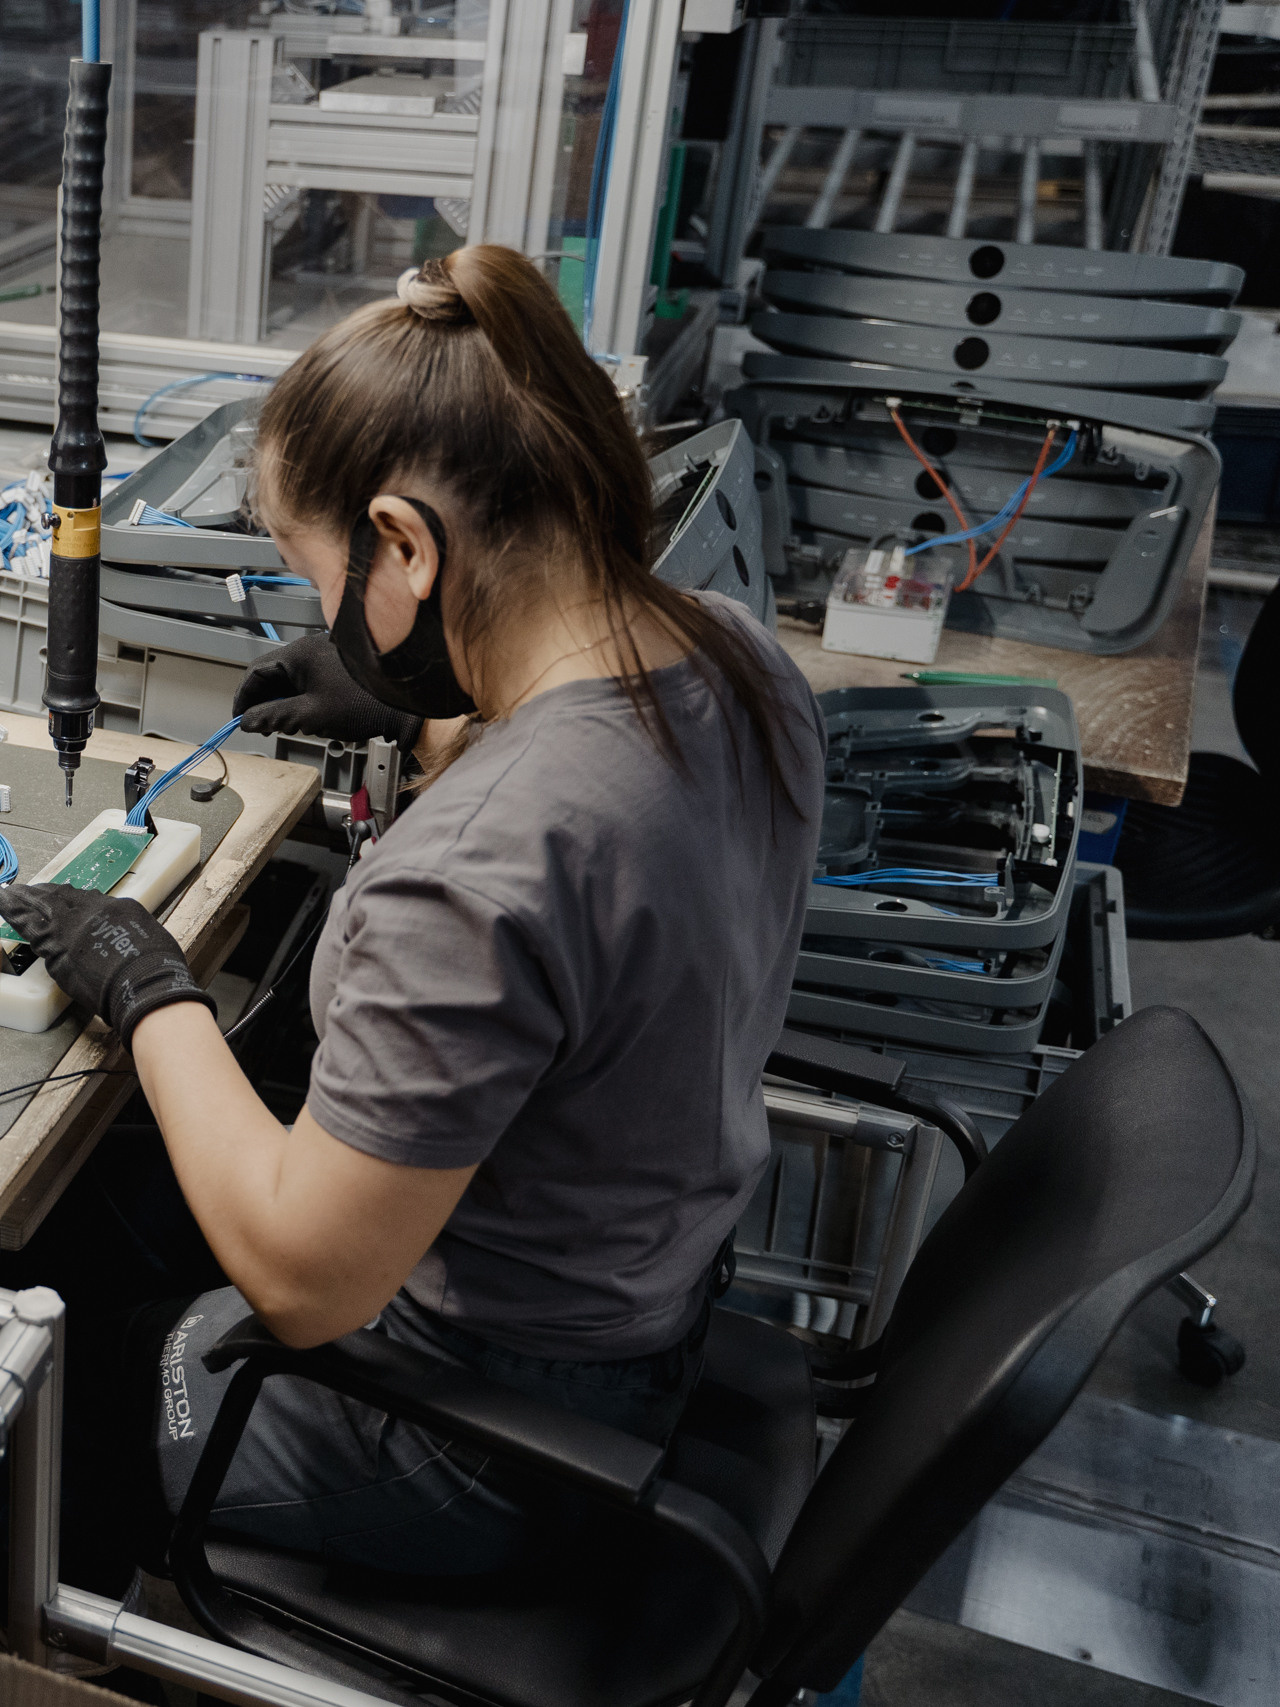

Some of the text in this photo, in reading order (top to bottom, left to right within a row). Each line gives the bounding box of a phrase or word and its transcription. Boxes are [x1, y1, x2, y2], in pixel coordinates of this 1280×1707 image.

[159, 1333, 179, 1441] THERMO GROUP
[170, 1330, 195, 1438] ARISTON
